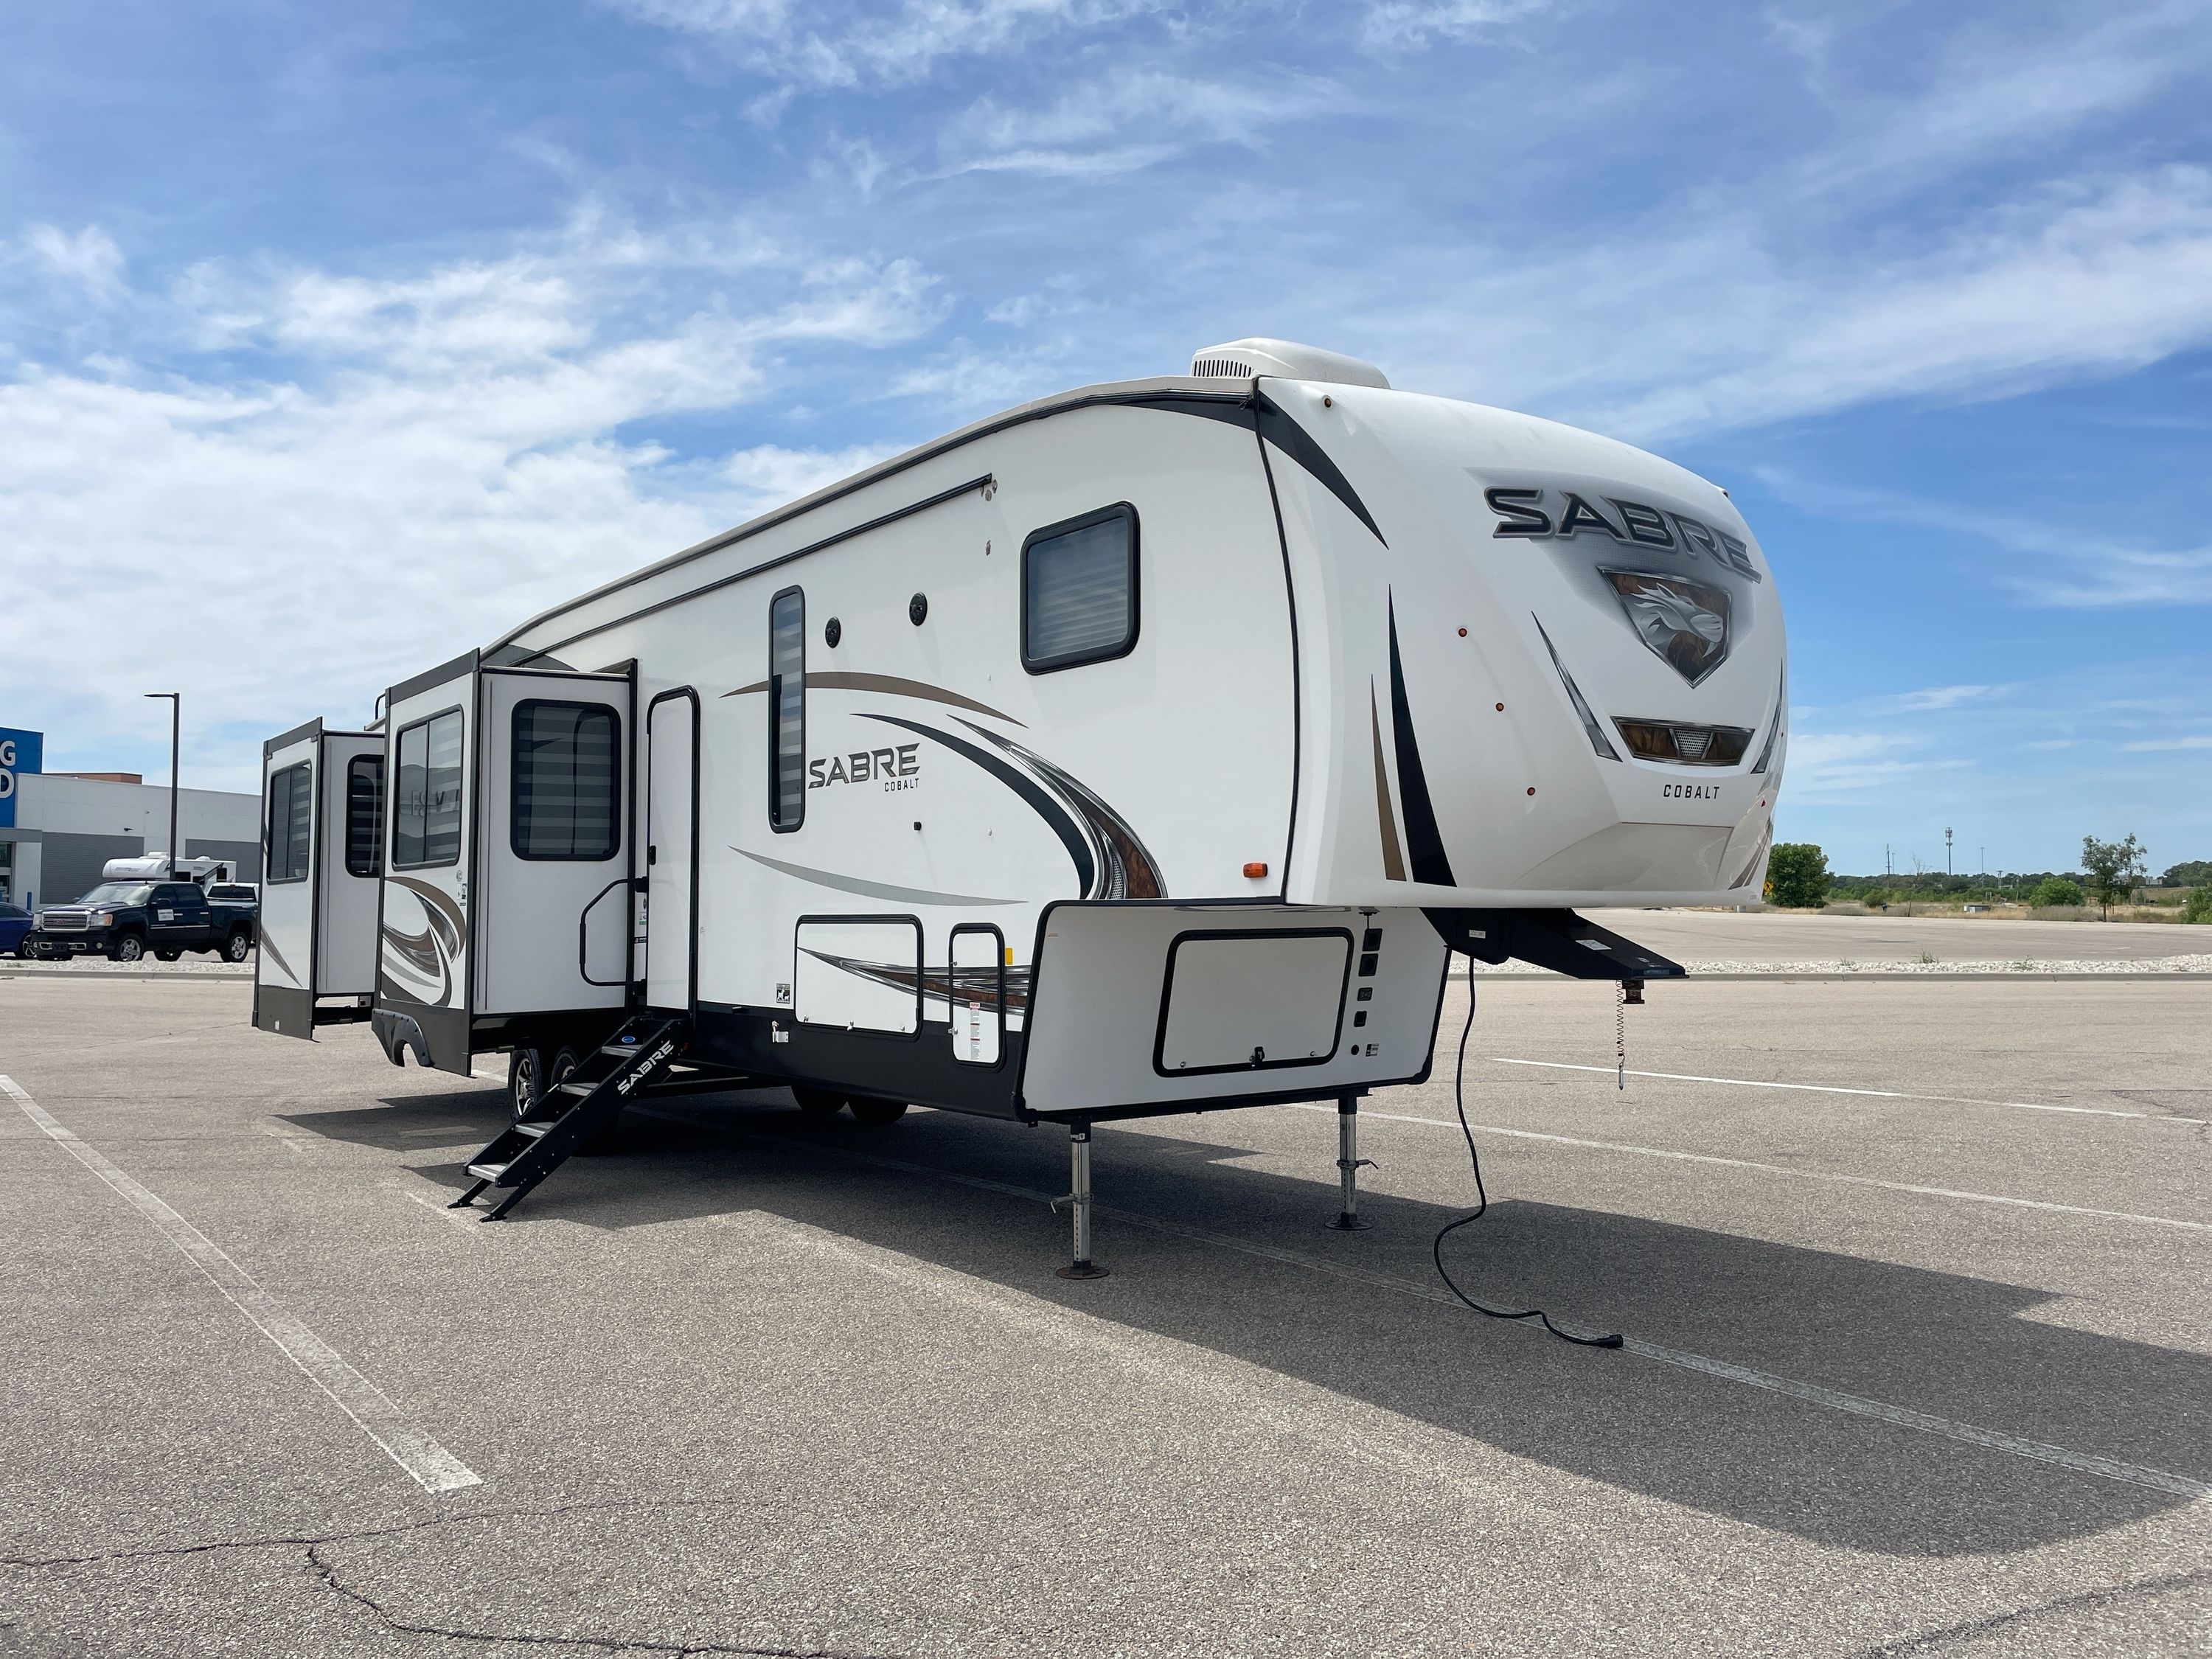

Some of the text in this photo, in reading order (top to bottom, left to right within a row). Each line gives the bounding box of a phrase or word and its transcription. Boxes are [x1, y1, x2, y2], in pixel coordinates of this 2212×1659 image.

[1484, 485, 1762, 584] SABRE
[0, 740, 15, 766] G
[808, 742, 921, 789] SABRE
[885, 778, 919, 792] COBALT
[1663, 783, 1720, 800] COBALT
[617, 1040, 674, 1095] SABRE
